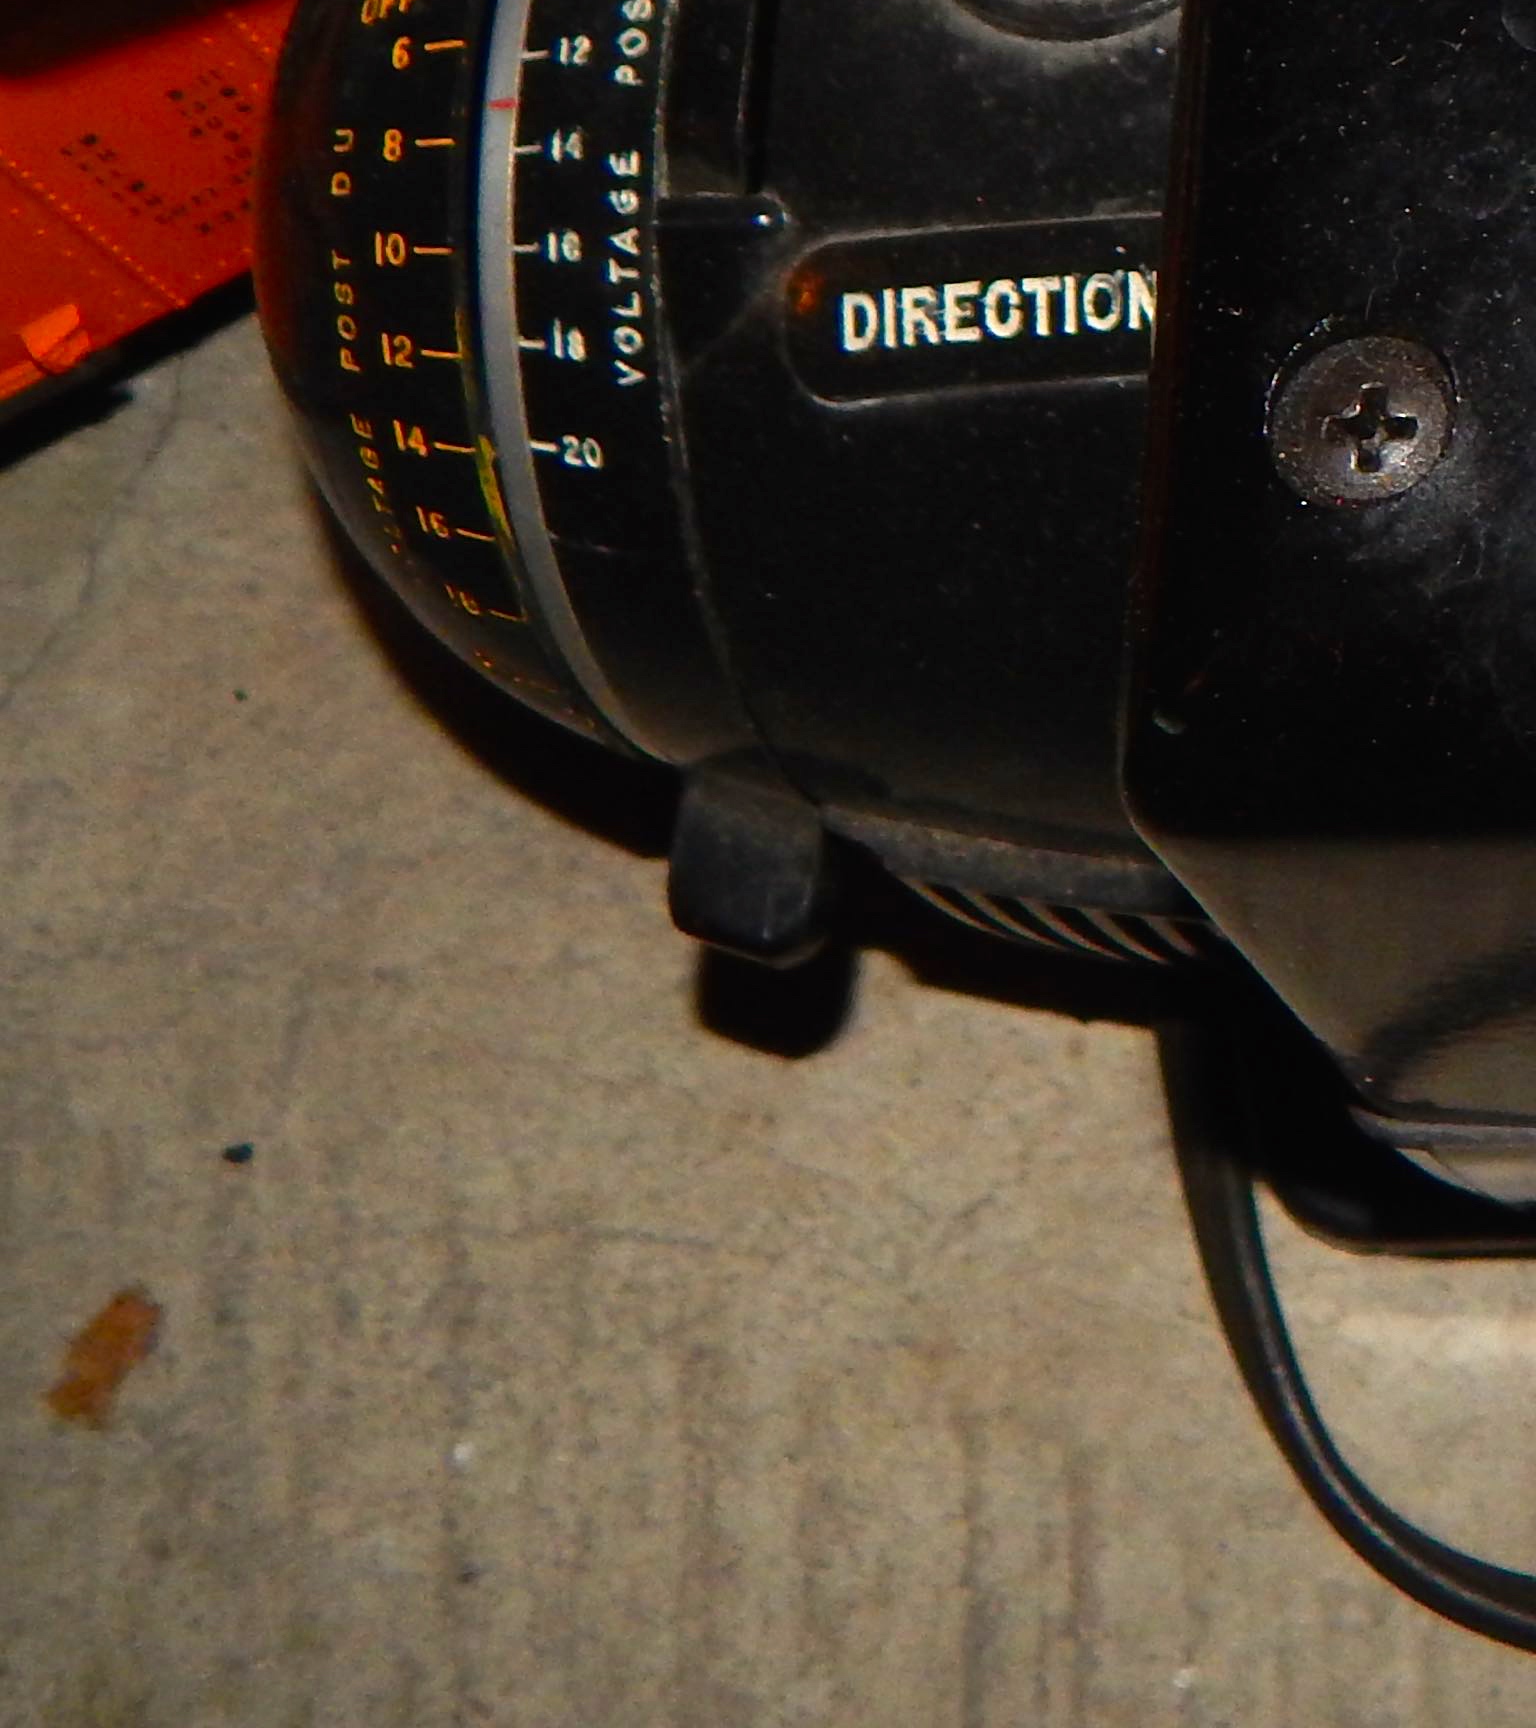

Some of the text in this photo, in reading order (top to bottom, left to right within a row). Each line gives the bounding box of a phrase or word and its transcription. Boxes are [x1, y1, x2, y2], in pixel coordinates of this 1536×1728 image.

[391, 37, 411, 69] 6
[558, 34, 592, 65] 12
[383, 129, 402, 163] 8
[550, 127, 585, 161] 14
[374, 231, 407, 266] 10
[607, 149, 646, 386] VOLTAGE
[332, 249, 361, 373] POST
[840, 269, 1157, 356] DIRECTION
[380, 332, 415, 370] 12
[551, 318, 587, 362] 18
[393, 419, 428, 458] 14
[561, 435, 604, 469] 20
[416, 505, 451, 540] 16
